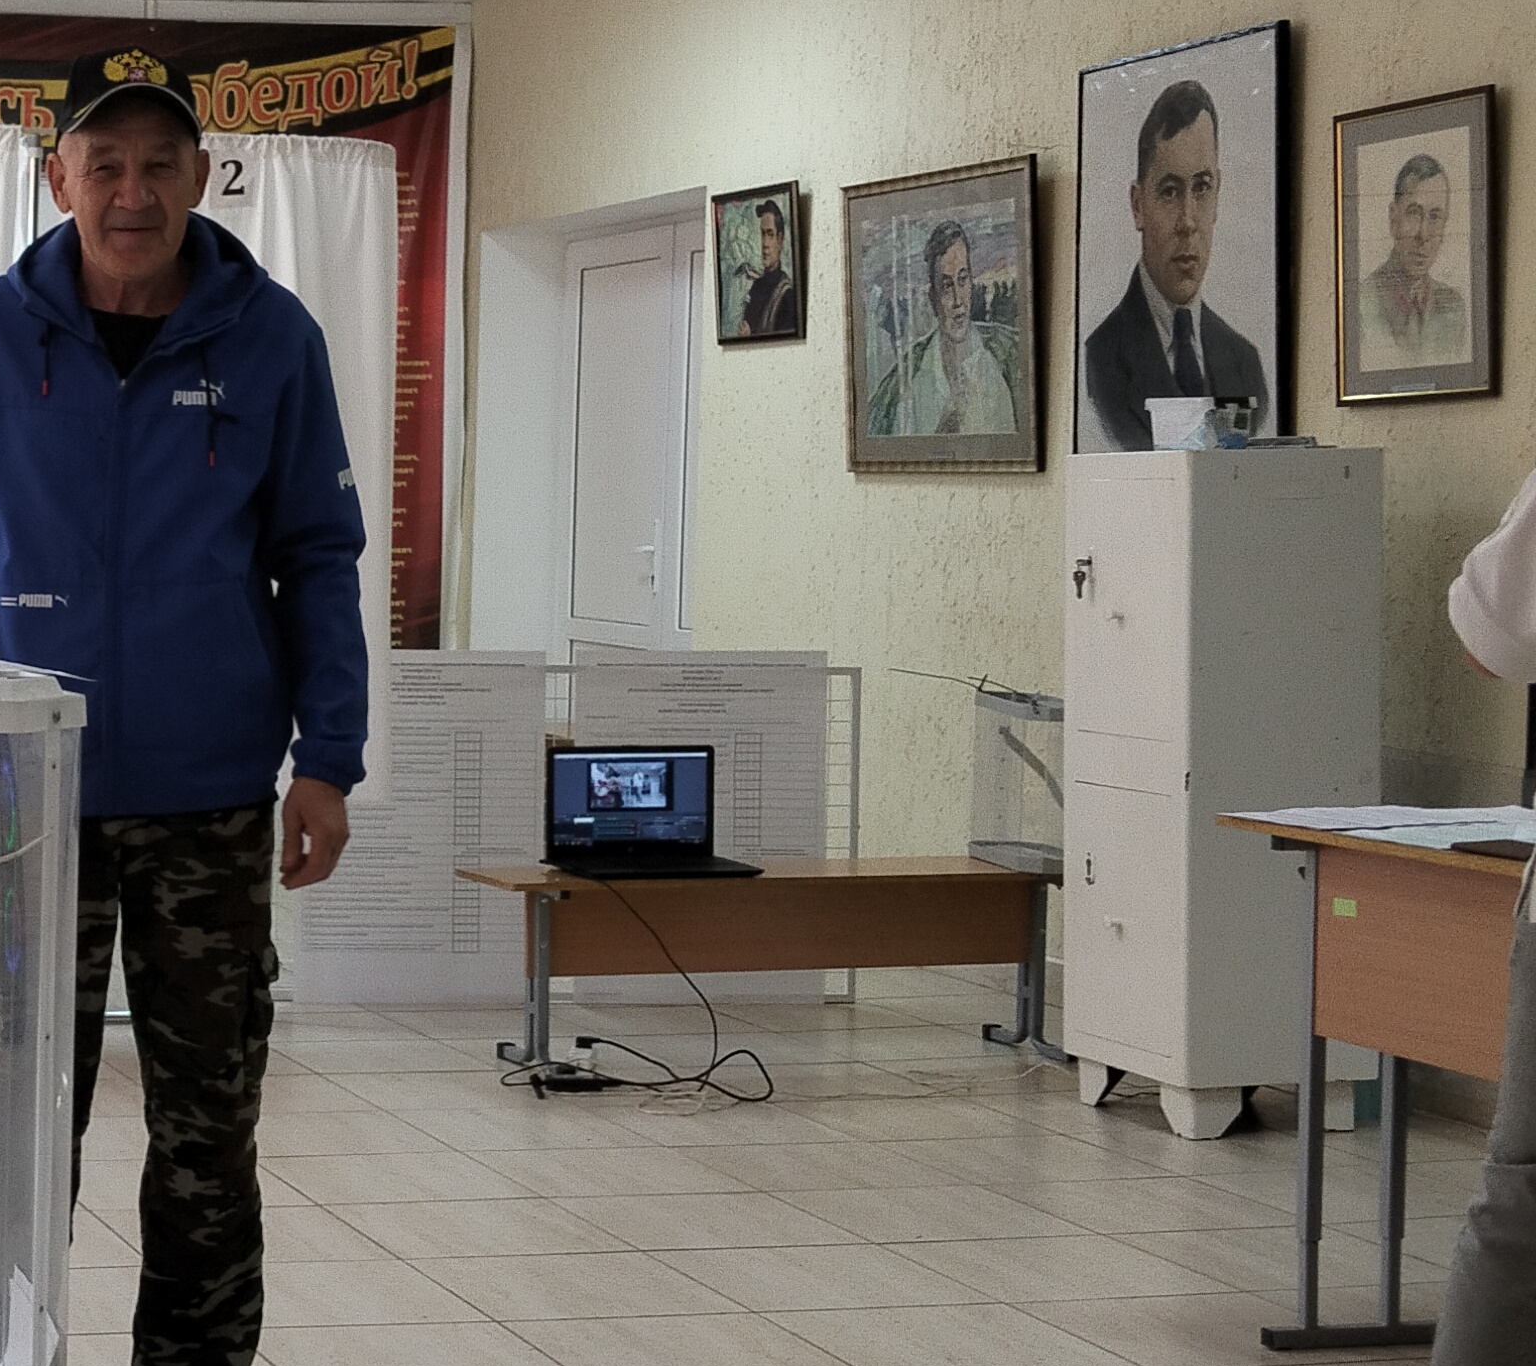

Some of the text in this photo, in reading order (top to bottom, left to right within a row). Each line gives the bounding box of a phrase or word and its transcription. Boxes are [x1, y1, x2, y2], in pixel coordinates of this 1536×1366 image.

[192, 39, 420, 132] обедой!
[220, 159, 245, 196] 2
[337, 467, 355, 490] PU
[18, 593, 53, 608] PUMA
